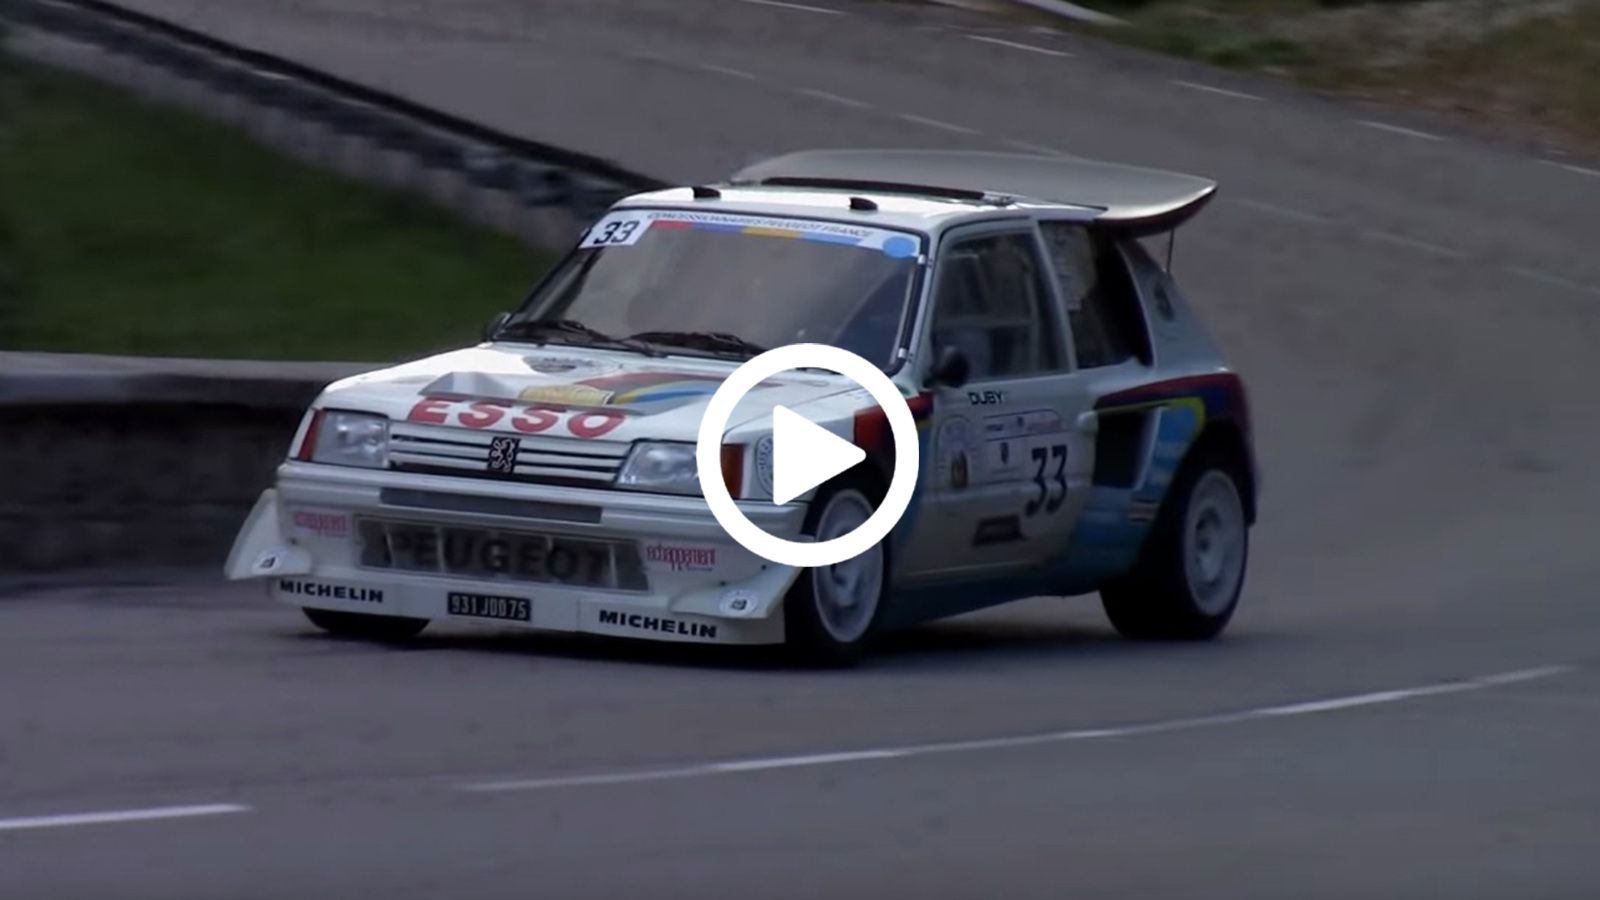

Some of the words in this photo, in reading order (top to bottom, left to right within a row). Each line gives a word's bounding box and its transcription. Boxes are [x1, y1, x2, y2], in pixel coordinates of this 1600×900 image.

[594, 219, 641, 245] 33
[968, 390, 1005, 405] DUBY
[407, 396, 625, 439] ESSO
[1025, 444, 1068, 518] 33
[394, 528, 607, 583] PEUGEOT
[279, 580, 384, 604] MICHELIN
[599, 609, 717, 639] MICHELIN
